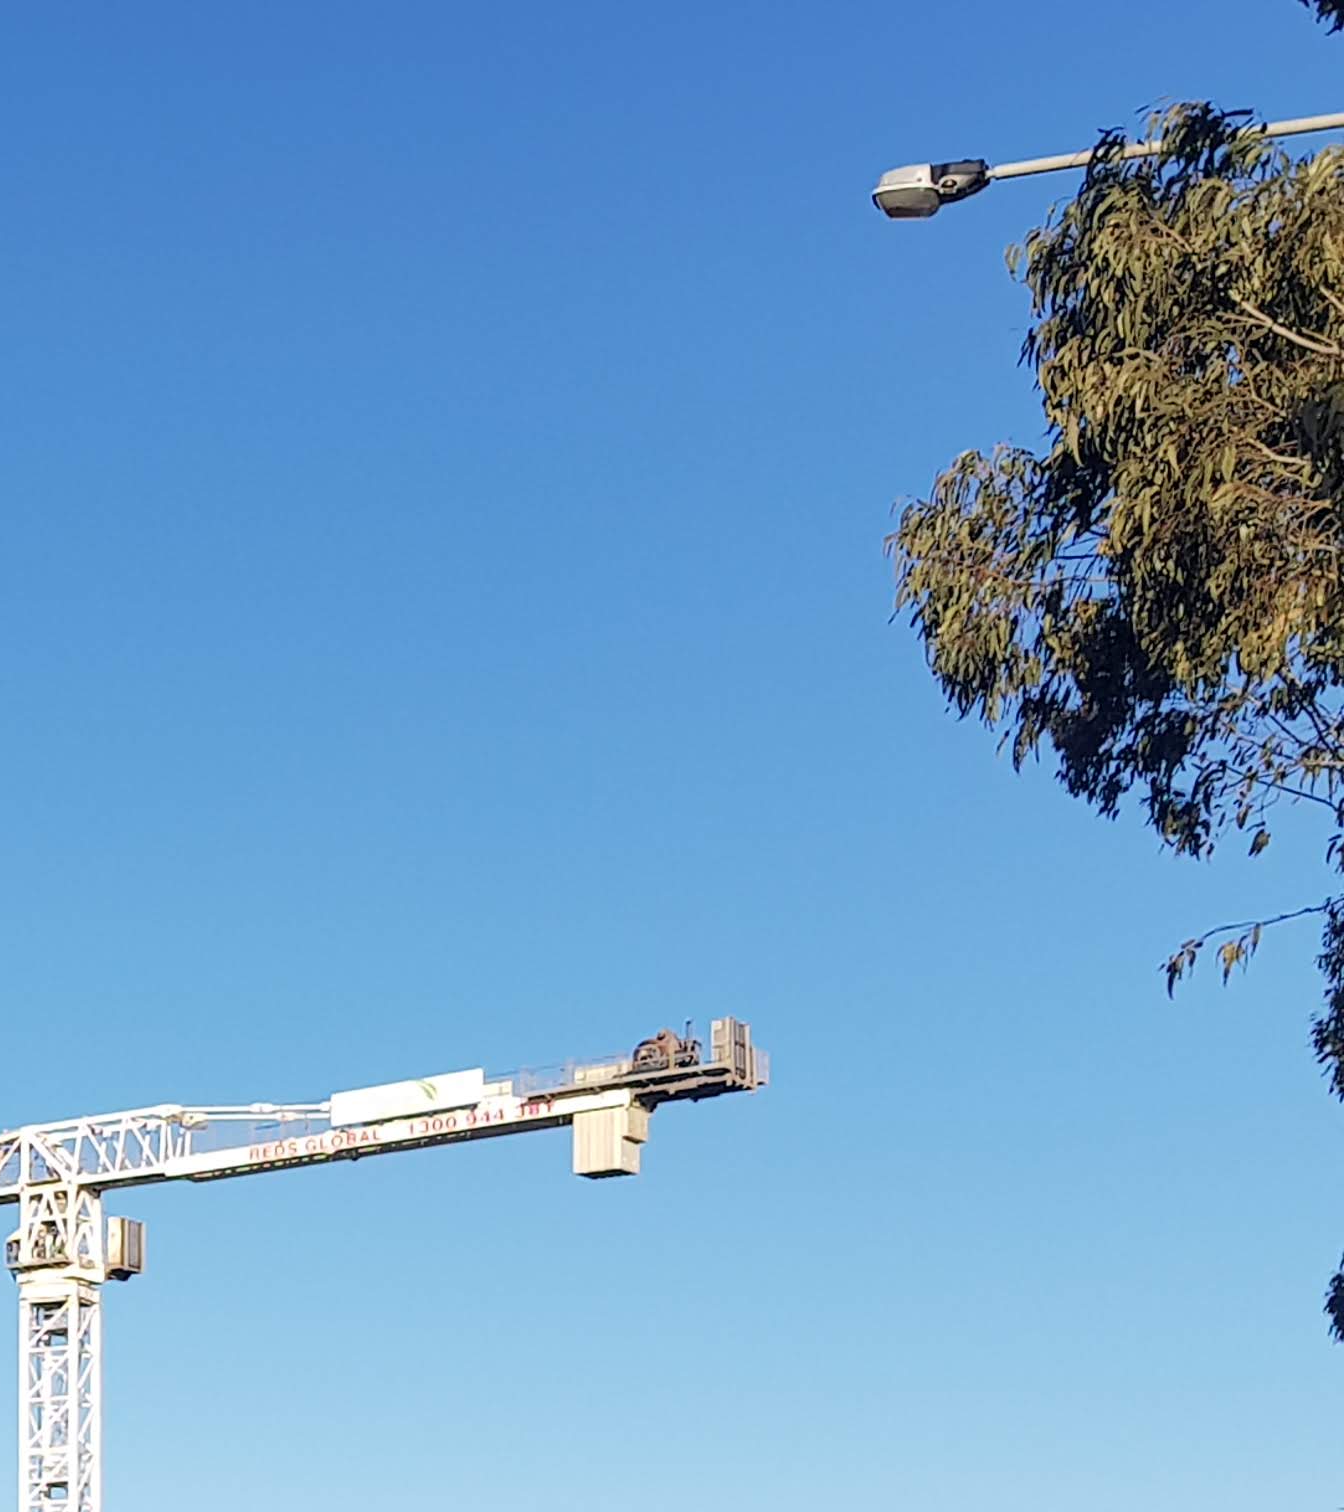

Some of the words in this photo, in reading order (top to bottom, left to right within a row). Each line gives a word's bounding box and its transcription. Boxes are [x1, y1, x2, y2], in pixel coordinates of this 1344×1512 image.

[305, 1130, 382, 1150] GLOBAL
[409, 1117, 457, 1135] 1300
[466, 1108, 505, 1126] 944
